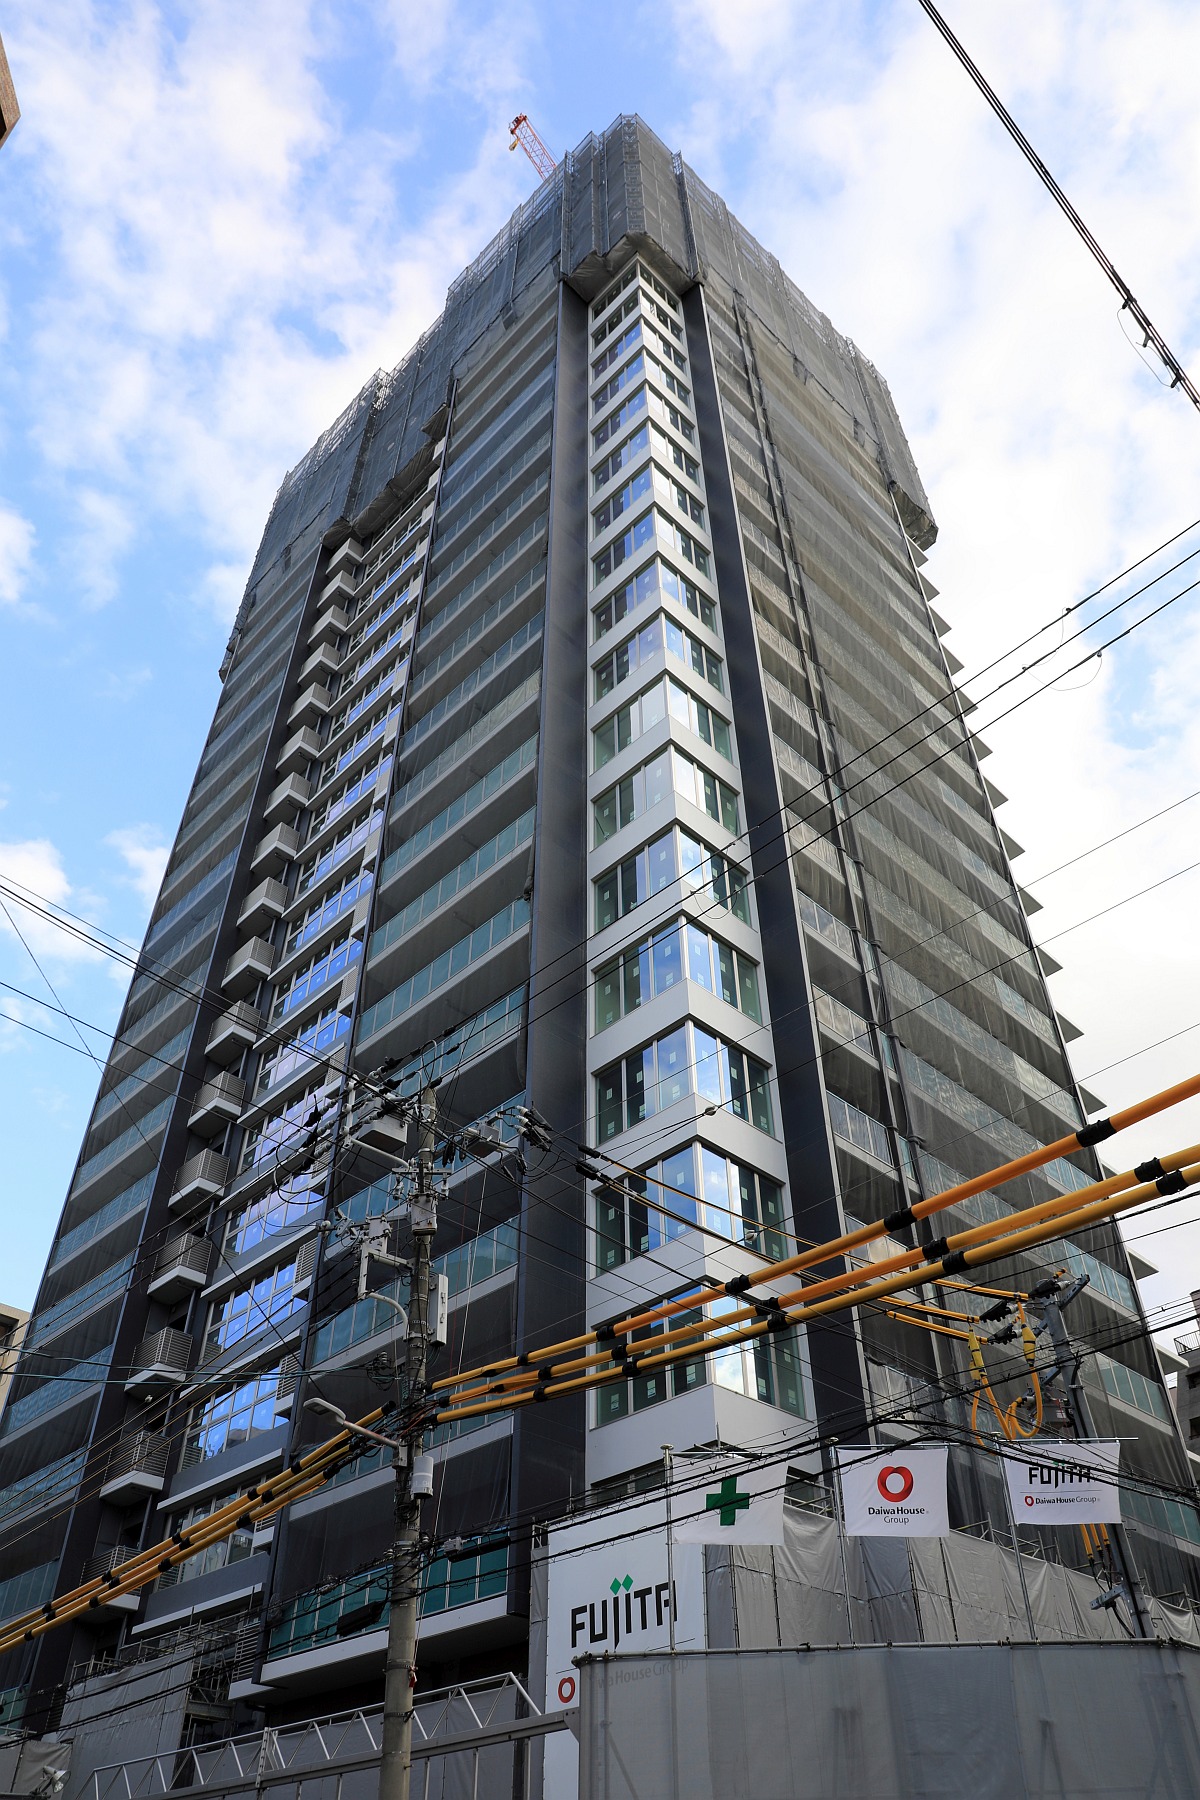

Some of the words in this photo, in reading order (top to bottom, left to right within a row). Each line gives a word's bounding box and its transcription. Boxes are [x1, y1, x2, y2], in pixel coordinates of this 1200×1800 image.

[1035, 1497, 1056, 1505] Daiwa
[1056, 1496, 1076, 1504] House
[1076, 1495, 1097, 1504] Group
[868, 1506, 896, 1515] Daiwa
[896, 1506, 925, 1515] House
[883, 1515, 910, 1525] Group
[571, 1574, 678, 1650] FUJITA
[615, 1666, 651, 1685] House
